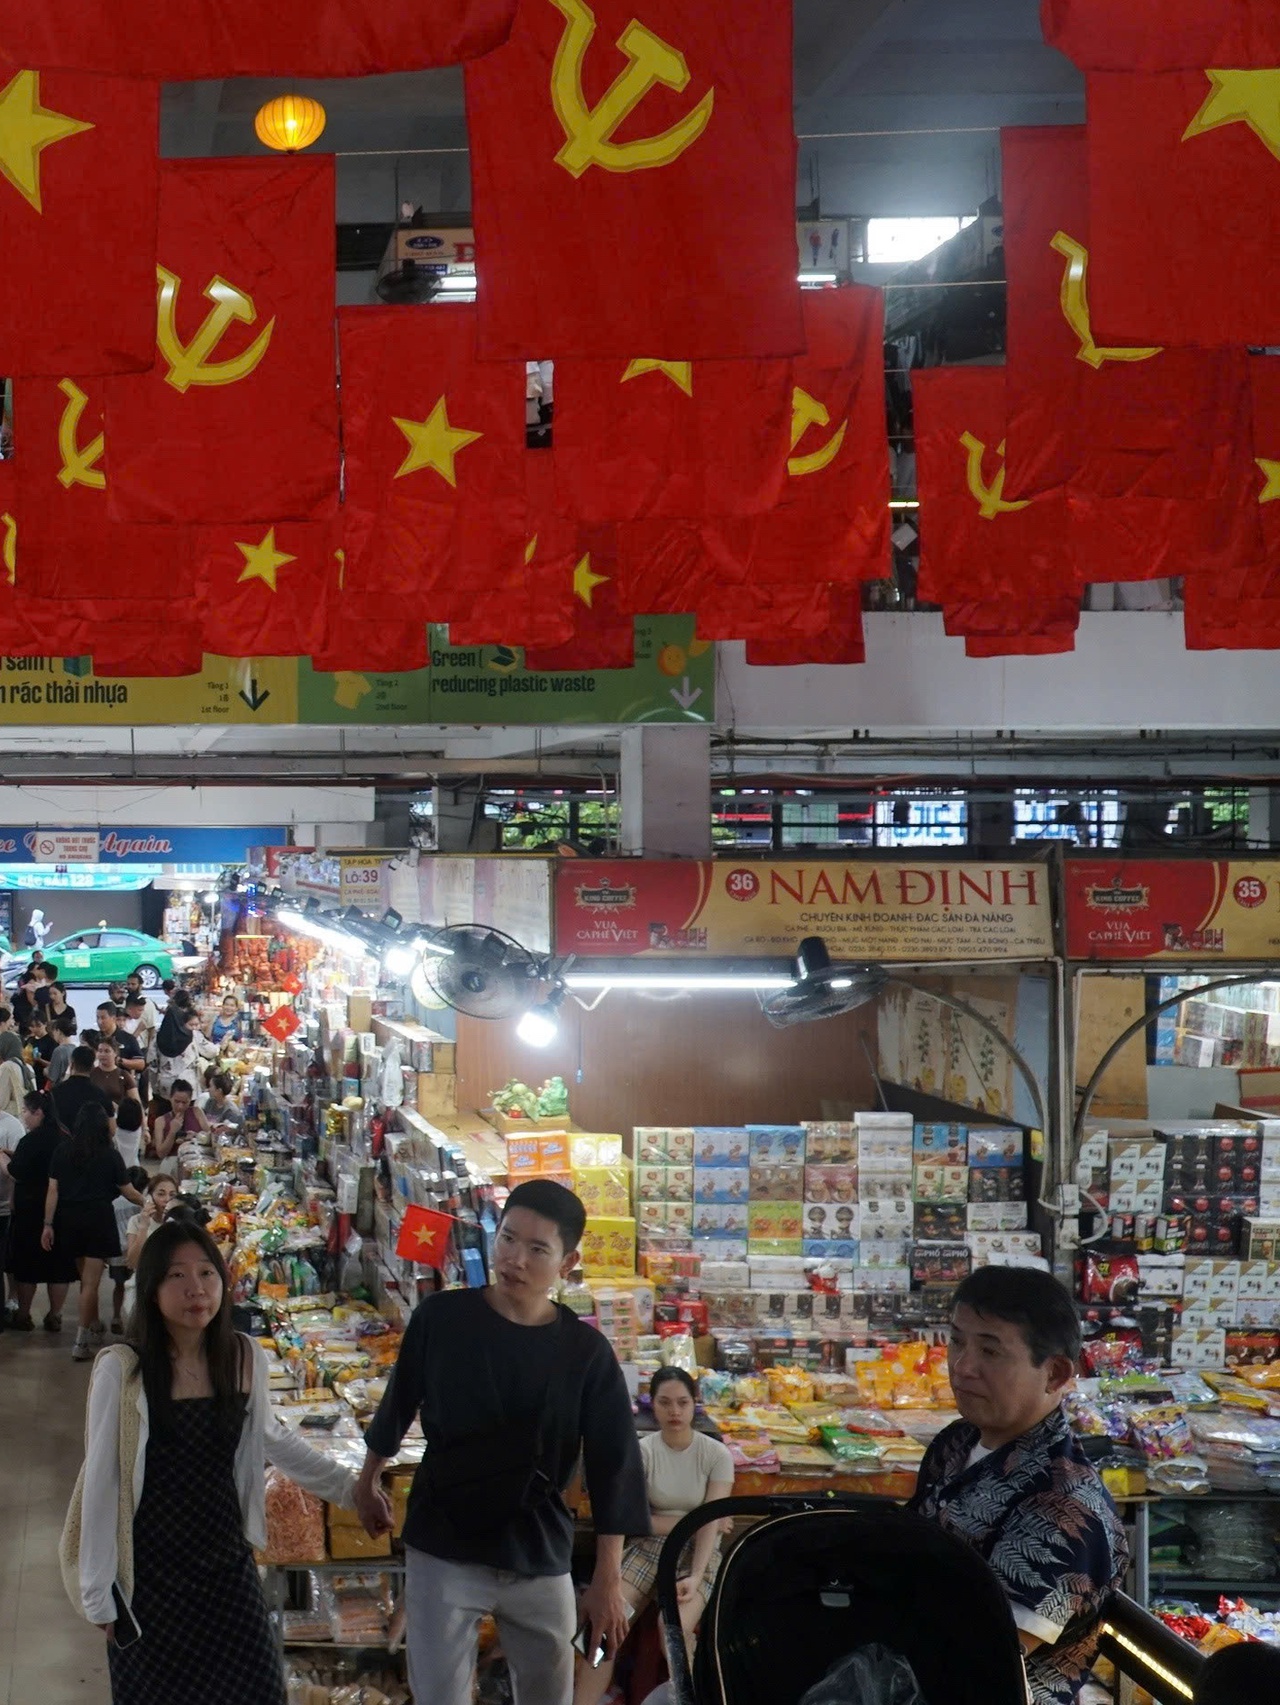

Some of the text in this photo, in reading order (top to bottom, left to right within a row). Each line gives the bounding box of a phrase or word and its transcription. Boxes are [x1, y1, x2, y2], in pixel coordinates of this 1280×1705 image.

[432, 649, 476, 667] Green
[10, 682, 42, 703] rác
[46, 680, 79, 703] thải
[84, 681, 128, 708] nhựa
[432, 675, 596, 697] reducing plastic waste
[213, 705, 230, 713] floor
[99, 831, 173, 858] Again
[731, 873, 754, 891] 36
[769, 869, 1040, 911] NAM ĐỊNH
[1238, 880, 1260, 898] 35
[594, 920, 618, 929] VUA
[800, 912, 844, 923] CHUYÊN
[845, 912, 871, 923] KINH
